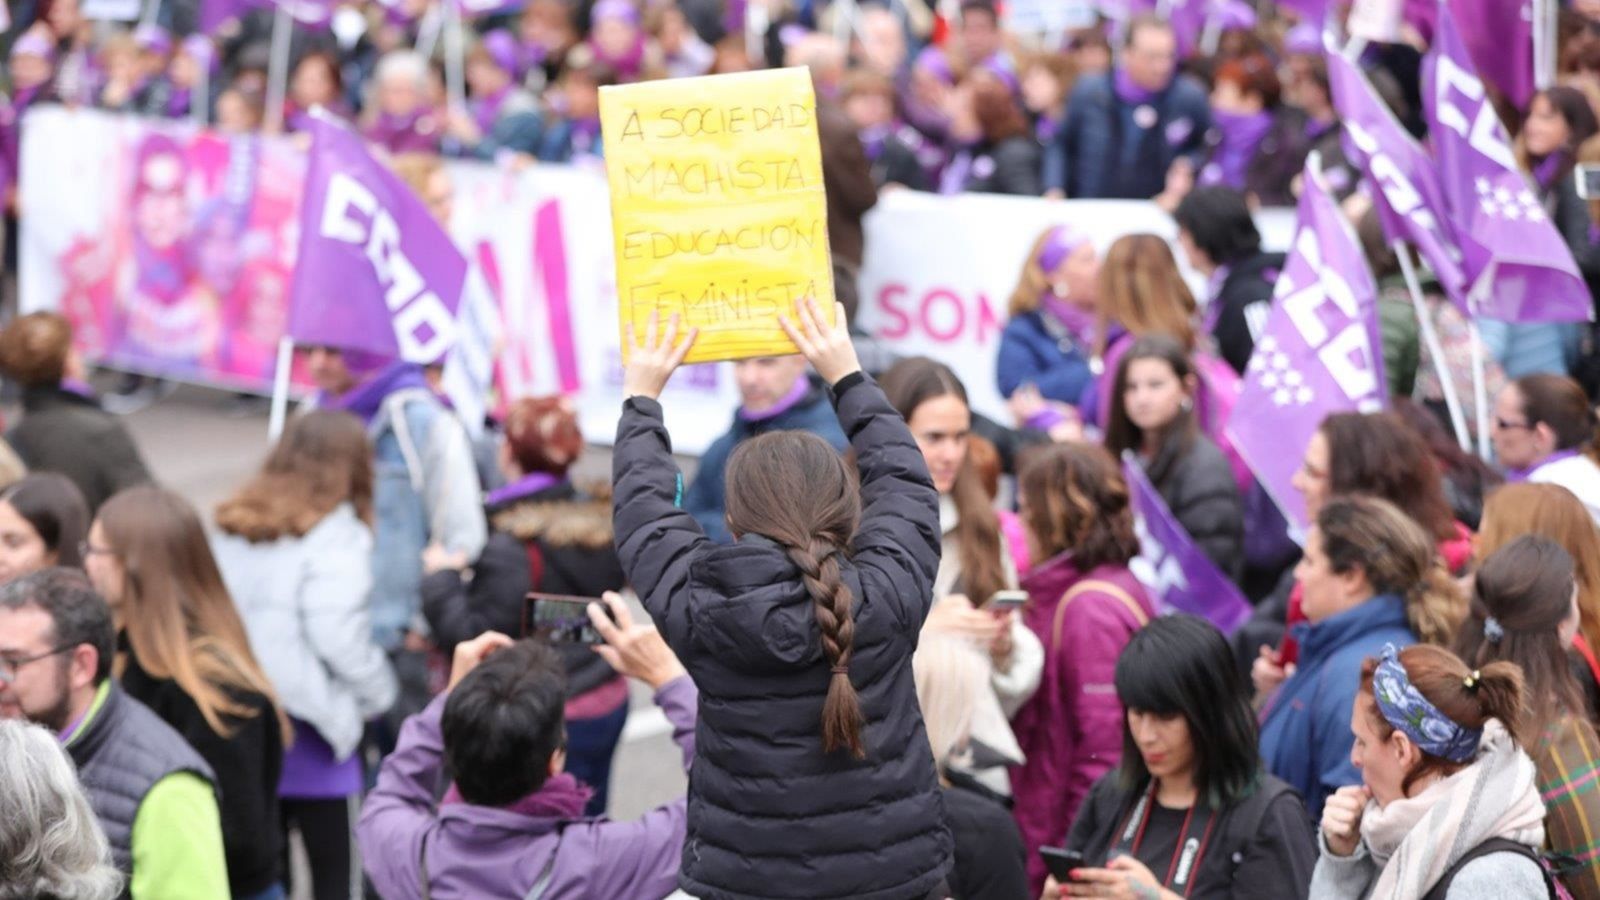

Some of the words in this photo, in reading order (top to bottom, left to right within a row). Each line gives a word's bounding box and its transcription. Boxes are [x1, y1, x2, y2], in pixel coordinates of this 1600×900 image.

[620, 108, 645, 142] A
[656, 103, 811, 139] SOCIEDAD
[624, 157, 806, 197] MACHISTA
[622, 218, 819, 260] EDUCACIÓN
